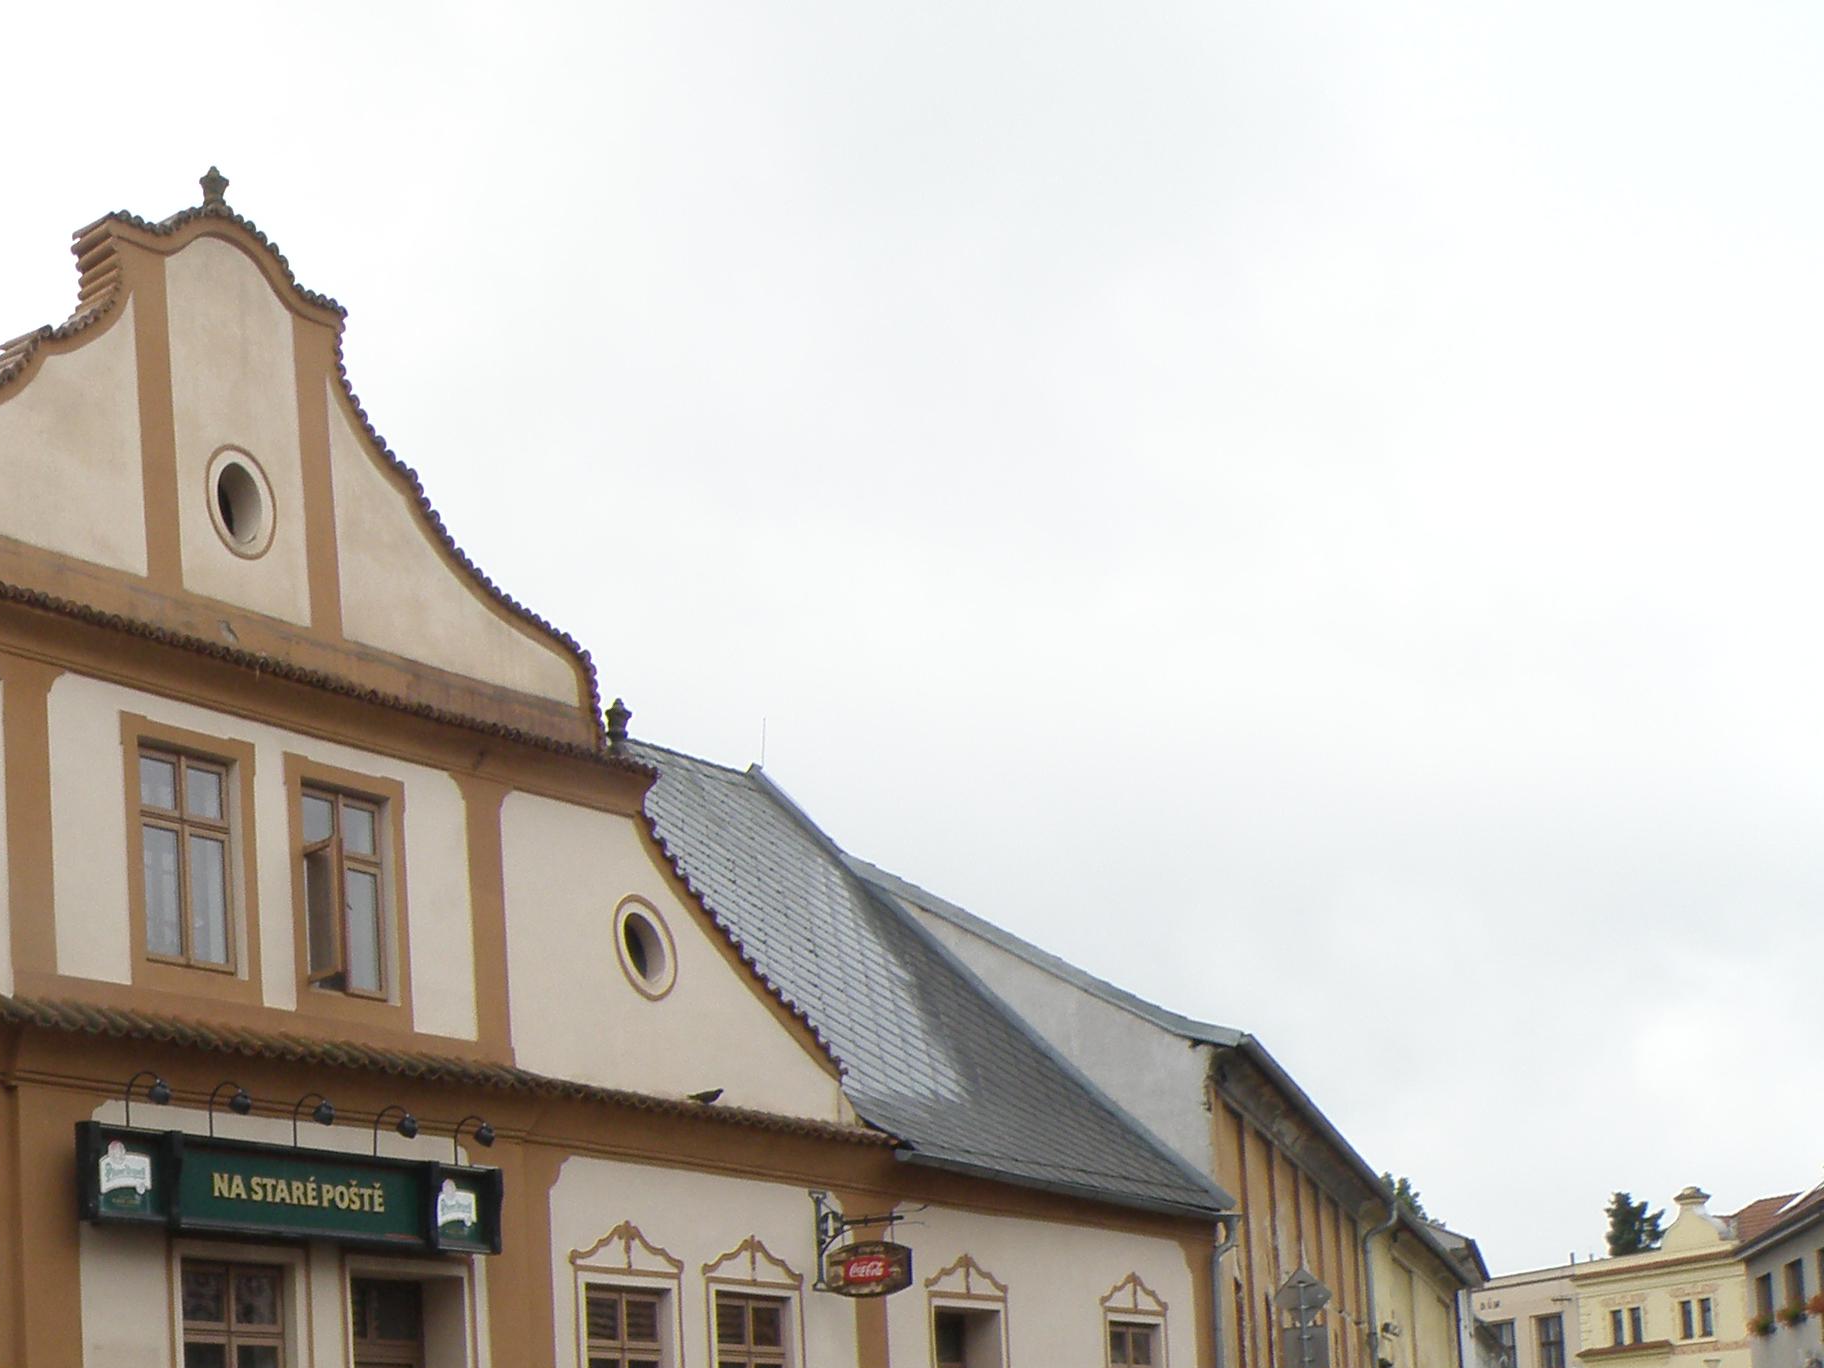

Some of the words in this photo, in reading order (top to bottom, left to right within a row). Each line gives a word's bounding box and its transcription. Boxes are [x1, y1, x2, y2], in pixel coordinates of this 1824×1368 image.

[212, 1172, 248, 1200] NA
[250, 1176, 319, 1207] STARÉ
[321, 1179, 385, 1213] POŠTĚ
